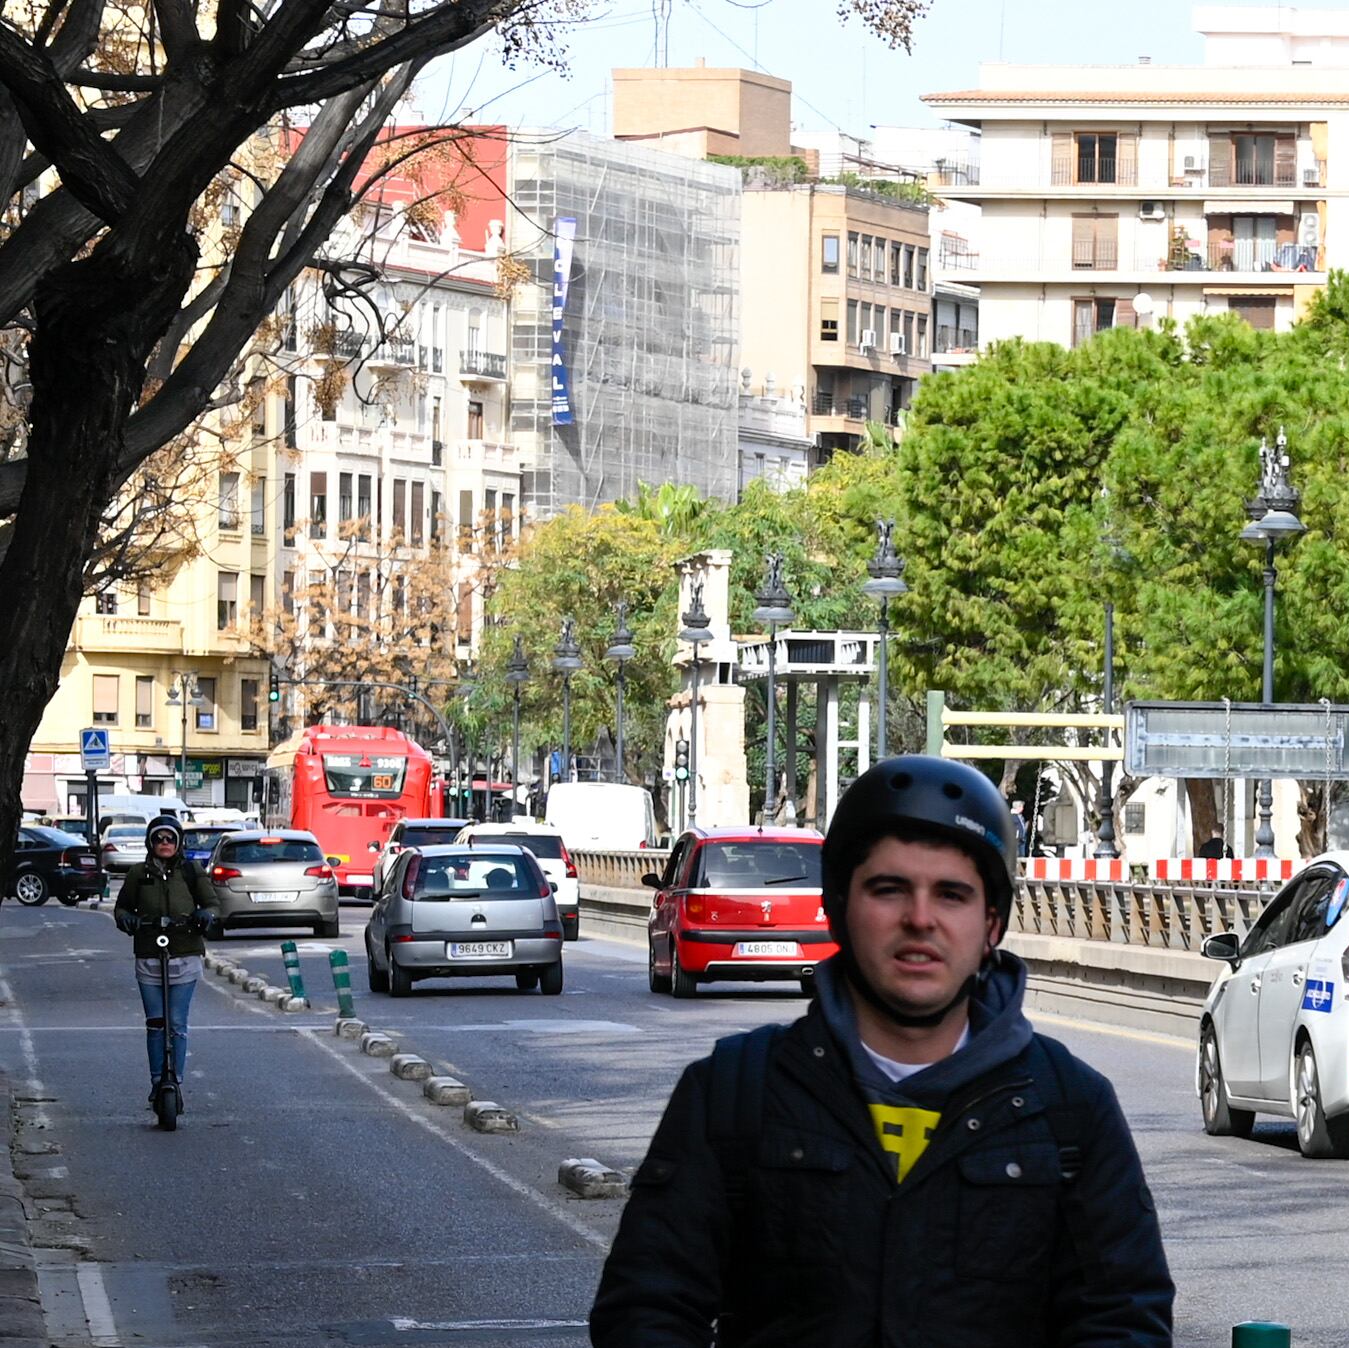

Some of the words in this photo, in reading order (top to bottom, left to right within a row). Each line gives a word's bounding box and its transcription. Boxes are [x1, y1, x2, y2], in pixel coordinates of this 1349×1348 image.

[373, 775, 391, 789] 60
[458, 944, 484, 954] 9649
[486, 943, 505, 953] CKZ
[747, 944, 773, 954] 4805
